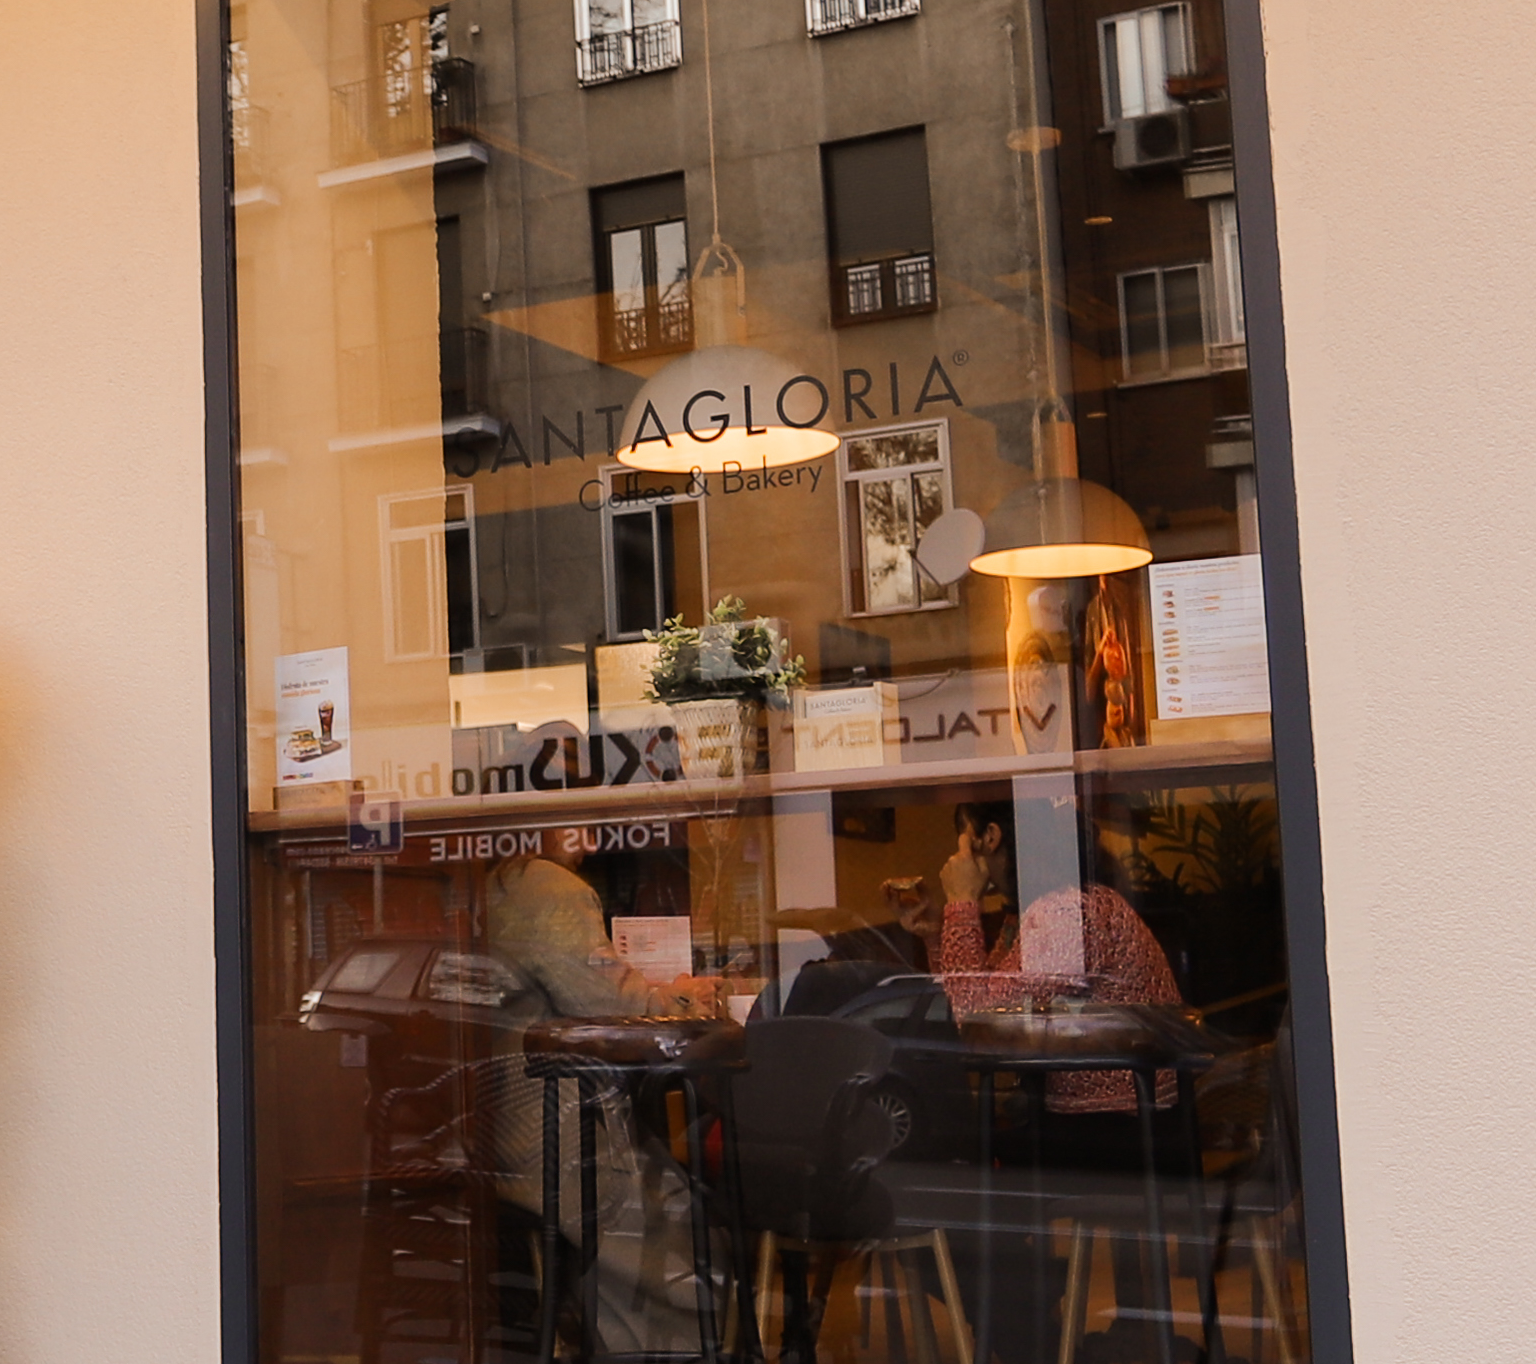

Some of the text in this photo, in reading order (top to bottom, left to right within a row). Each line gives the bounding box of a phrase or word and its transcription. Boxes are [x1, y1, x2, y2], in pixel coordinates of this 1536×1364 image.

[451, 355, 963, 478] SANTAGLORIA
[579, 455, 823, 513] Coffee & Bakery
